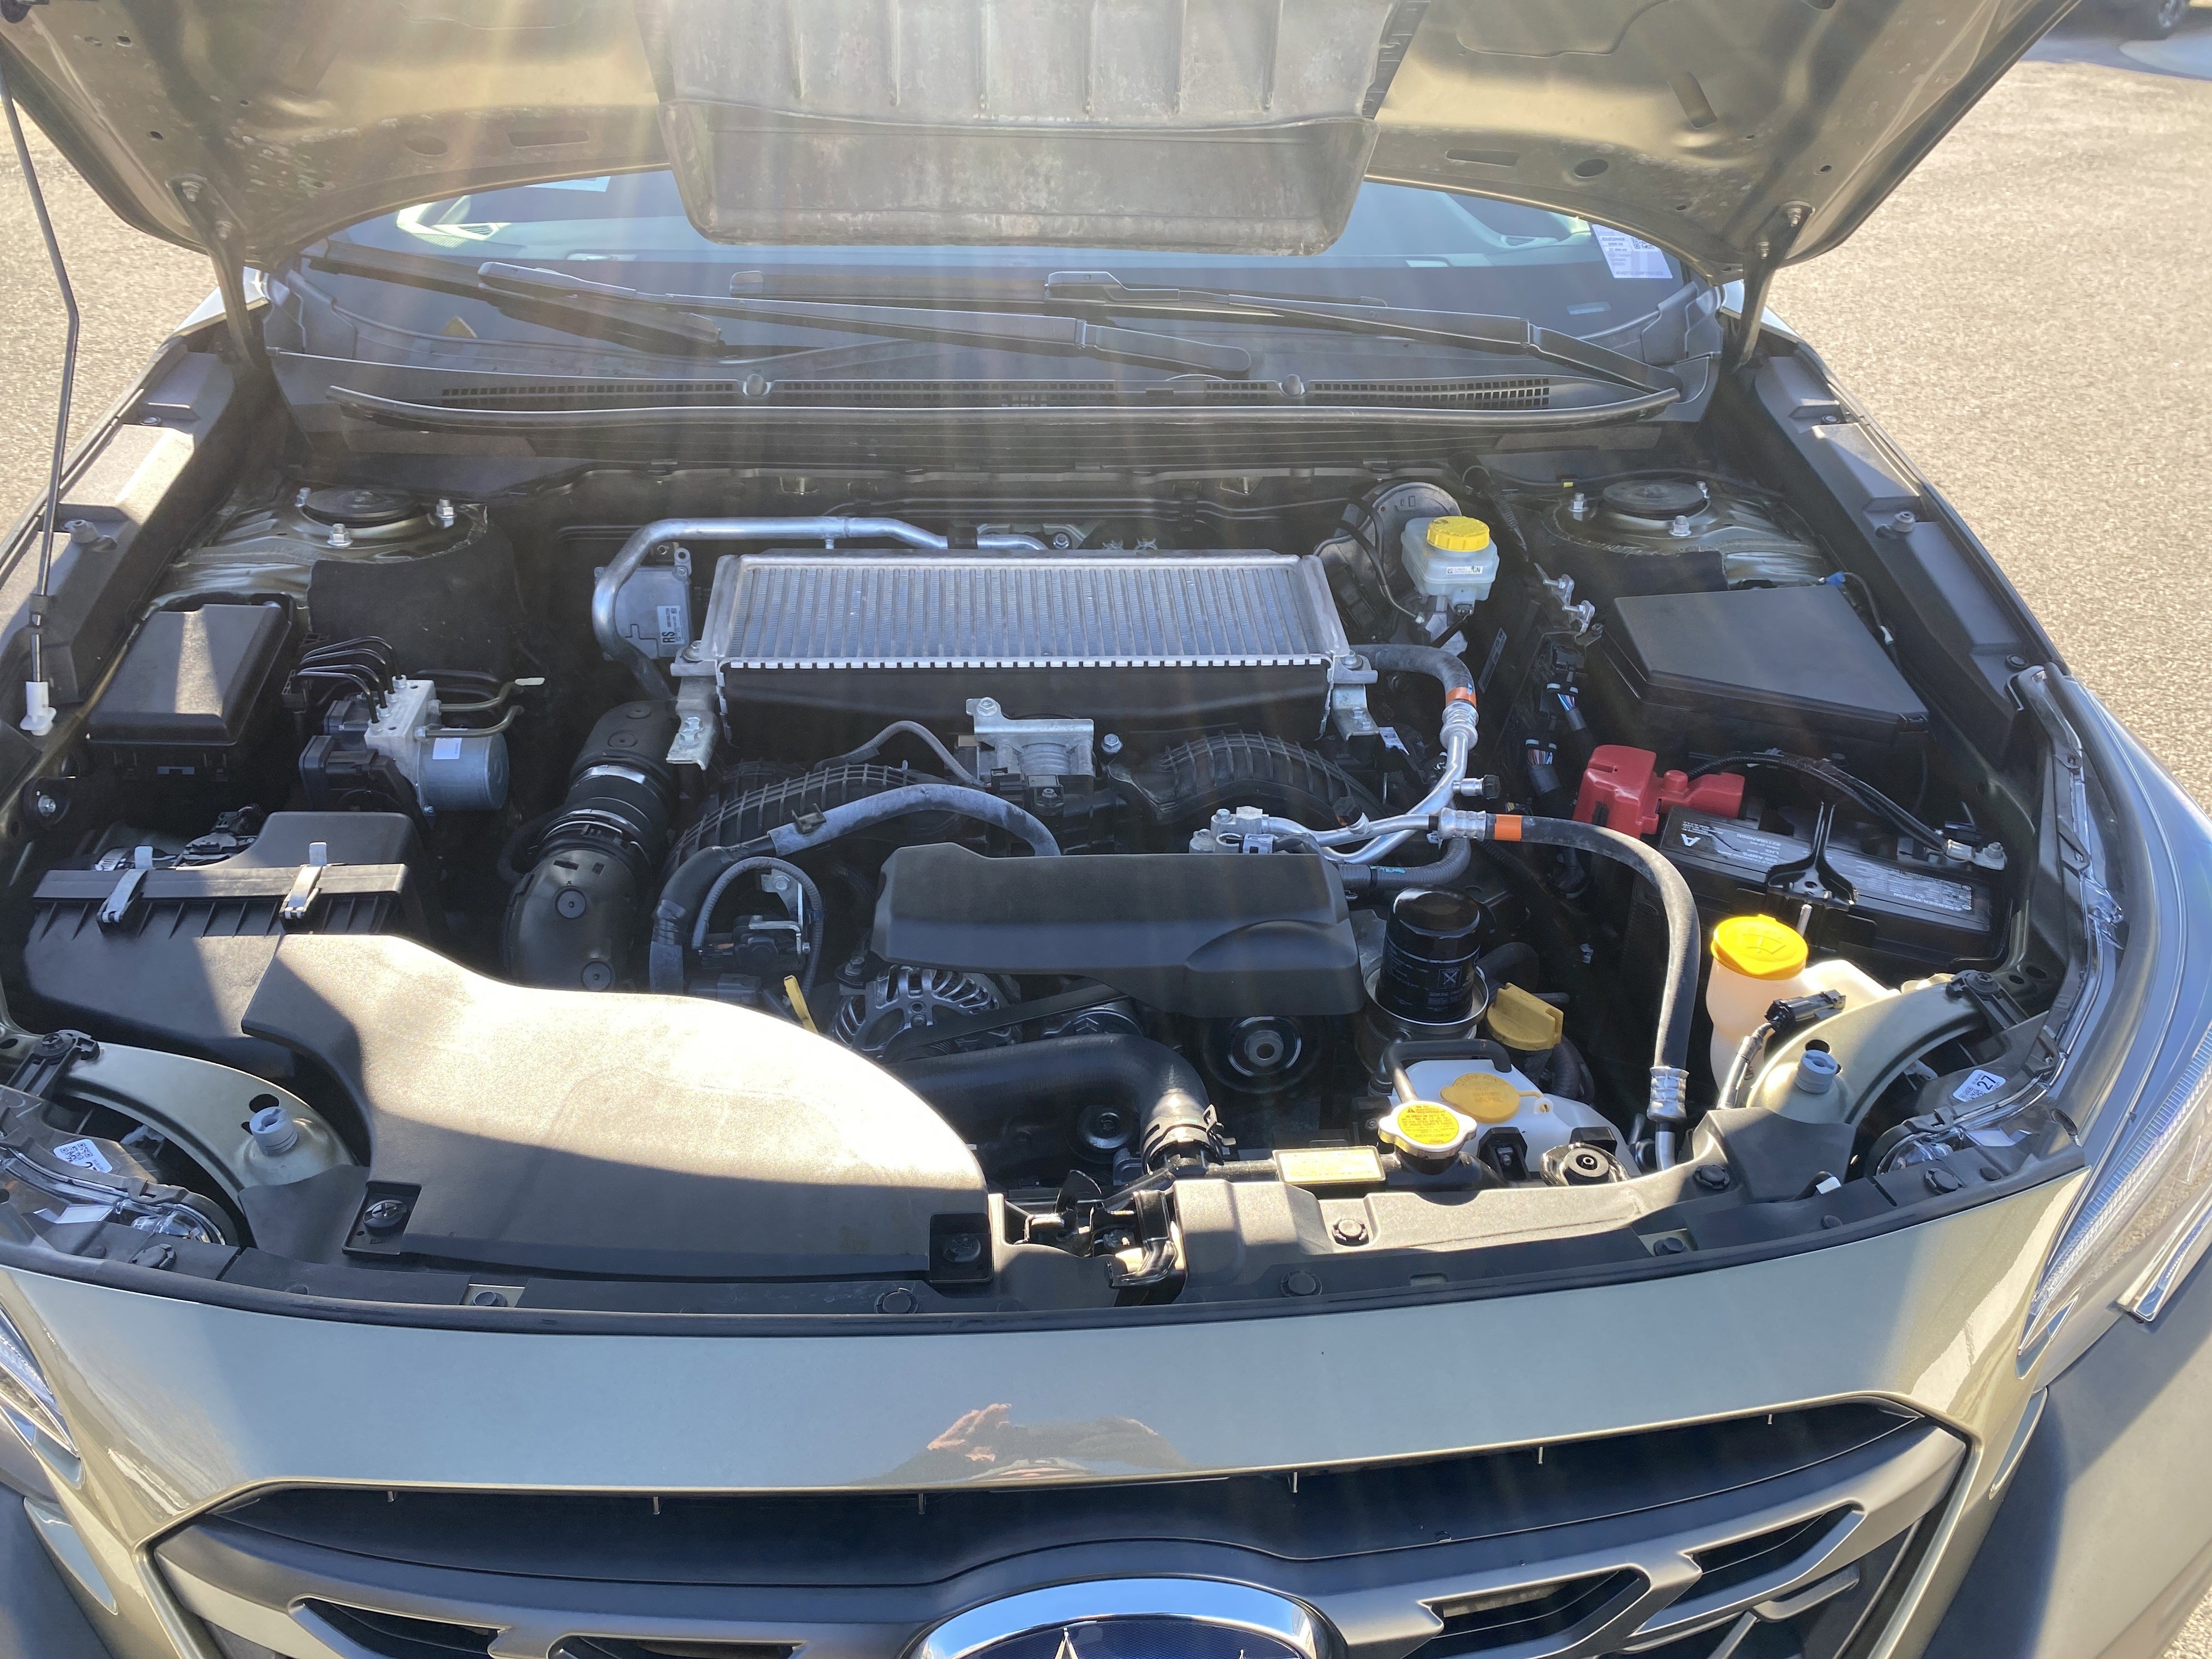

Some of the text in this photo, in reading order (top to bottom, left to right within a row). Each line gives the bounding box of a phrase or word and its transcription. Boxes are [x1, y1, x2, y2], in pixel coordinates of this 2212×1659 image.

[662, 632, 675, 642] RS
[1681, 833, 1701, 847] A
[1742, 851, 1763, 860] AMPS
[1977, 1075, 1996, 1090] 27
